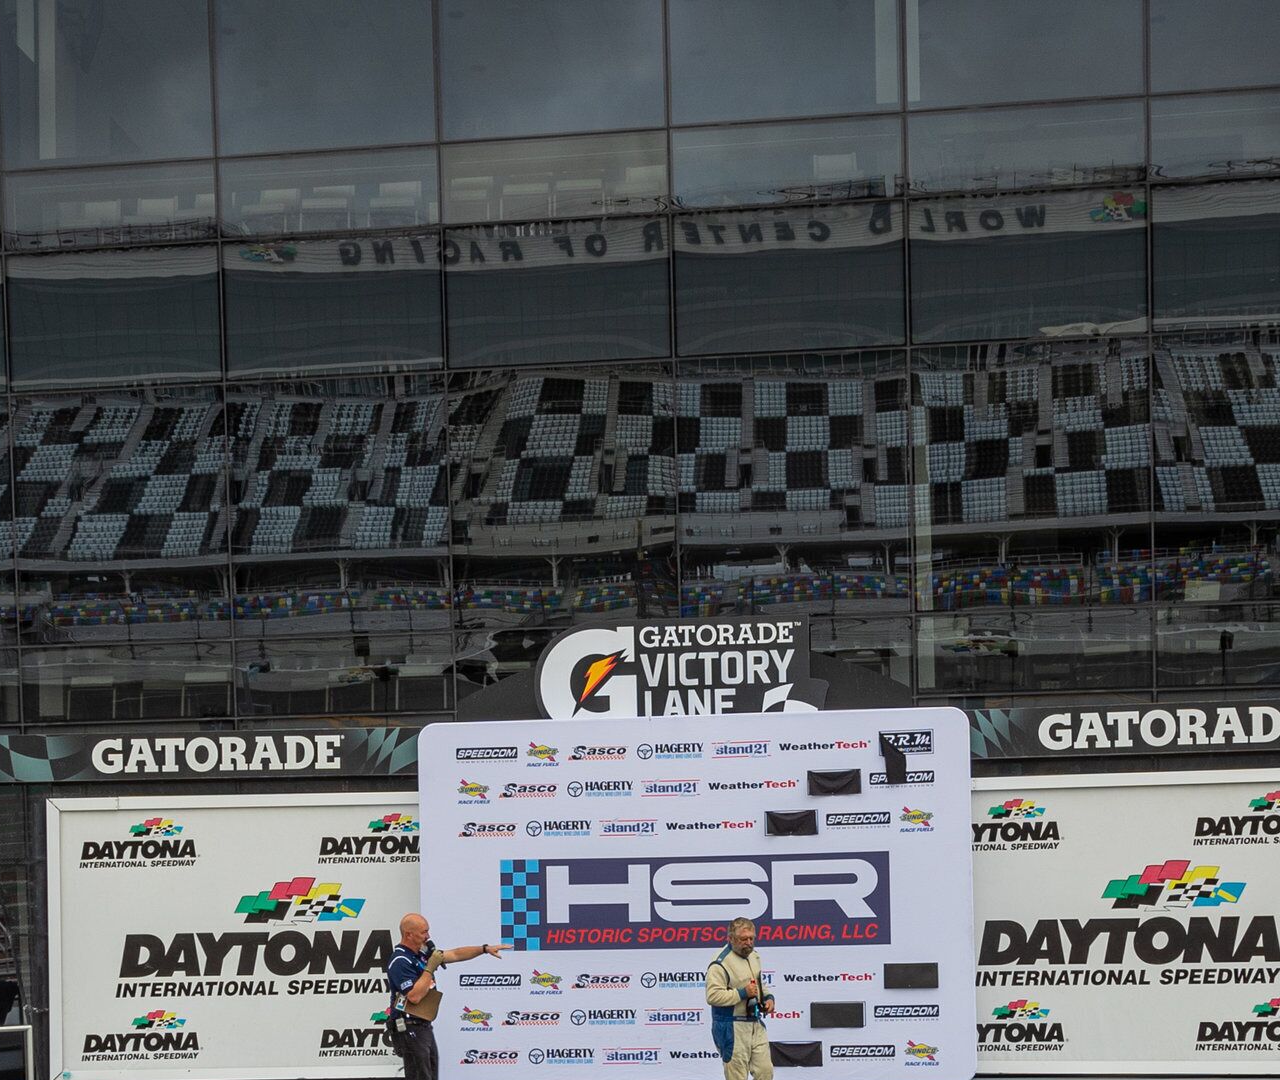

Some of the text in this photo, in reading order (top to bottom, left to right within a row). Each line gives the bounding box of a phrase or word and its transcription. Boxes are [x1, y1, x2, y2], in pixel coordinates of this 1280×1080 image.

[639, 622, 793, 648] GATORADE
[540, 626, 636, 720] G
[640, 649, 795, 687] VICTORY
[91, 735, 341, 774] GATORADE
[526, 747, 559, 756] SUNOCO
[571, 745, 626, 761] Sasco
[655, 742, 704, 754] HAGERTY
[715, 743, 768, 755] stand21
[779, 740, 868, 751] WeatherTech
[457, 772, 934, 798] SUNOCO Sasco HAGERTY stand21 WeatherTech SPCOM.
[462, 822, 516, 837] Sasco
[544, 821, 592, 831] HAGERTY
[603, 822, 655, 833] stand21
[666, 820, 754, 830] WeatherTech
[900, 812, 933, 822] SUNOCO
[972, 821, 1059, 842] YTONA
[80, 838, 197, 860] DAYTONA
[319, 835, 421, 856] DAYTON
[1010, 842, 1059, 851] SPEEDWAY
[1193, 836, 1269, 846] INTERNATIONAL
[79, 859, 196, 869] INTERNATIONAL SPEEDWAY
[318, 854, 421, 865] INTERNATIONAL SPEED
[546, 857, 879, 924] HSR
[546, 921, 879, 944] HISTORIC SPORTSC RACING, LLC
[119, 930, 395, 979] DAYTONA
[529, 975, 562, 984] SUNOCO
[575, 974, 631, 988] Sasco
[659, 971, 706, 982] HAGERTY
[783, 972, 873, 982] WeatherTech
[975, 966, 1280, 987] INTERNATIONAL SPEEDWAY
[116, 980, 279, 998] INTERNATIONAL
[286, 978, 391, 996] SPEEDWAY
[460, 1012, 493, 1021] SUNOCO
[505, 1011, 560, 1026] Sasco
[588, 1010, 637, 1020] HAGERTY
[648, 1011, 701, 1022] stand21
[83, 1031, 199, 1053] DAYTONA
[320, 1028, 392, 1049] DAYTO
[977, 1022, 1065, 1043] YTONA
[81, 1052, 199, 1062] INTERNATIONAL SPEEDWAY
[318, 1048, 388, 1058] INTERNATIONAL
[464, 1049, 518, 1064] Sasco
[546, 1048, 595, 1059] HAGERTY
[606, 1050, 658, 1062] stand21
[670, 1050, 721, 1059] Weathe
[904, 1046, 938, 1055] SUNOCO
[1015, 1043, 1064, 1052] SPEEDWAY
[1195, 1042, 1271, 1052] INTERNATIONAL
